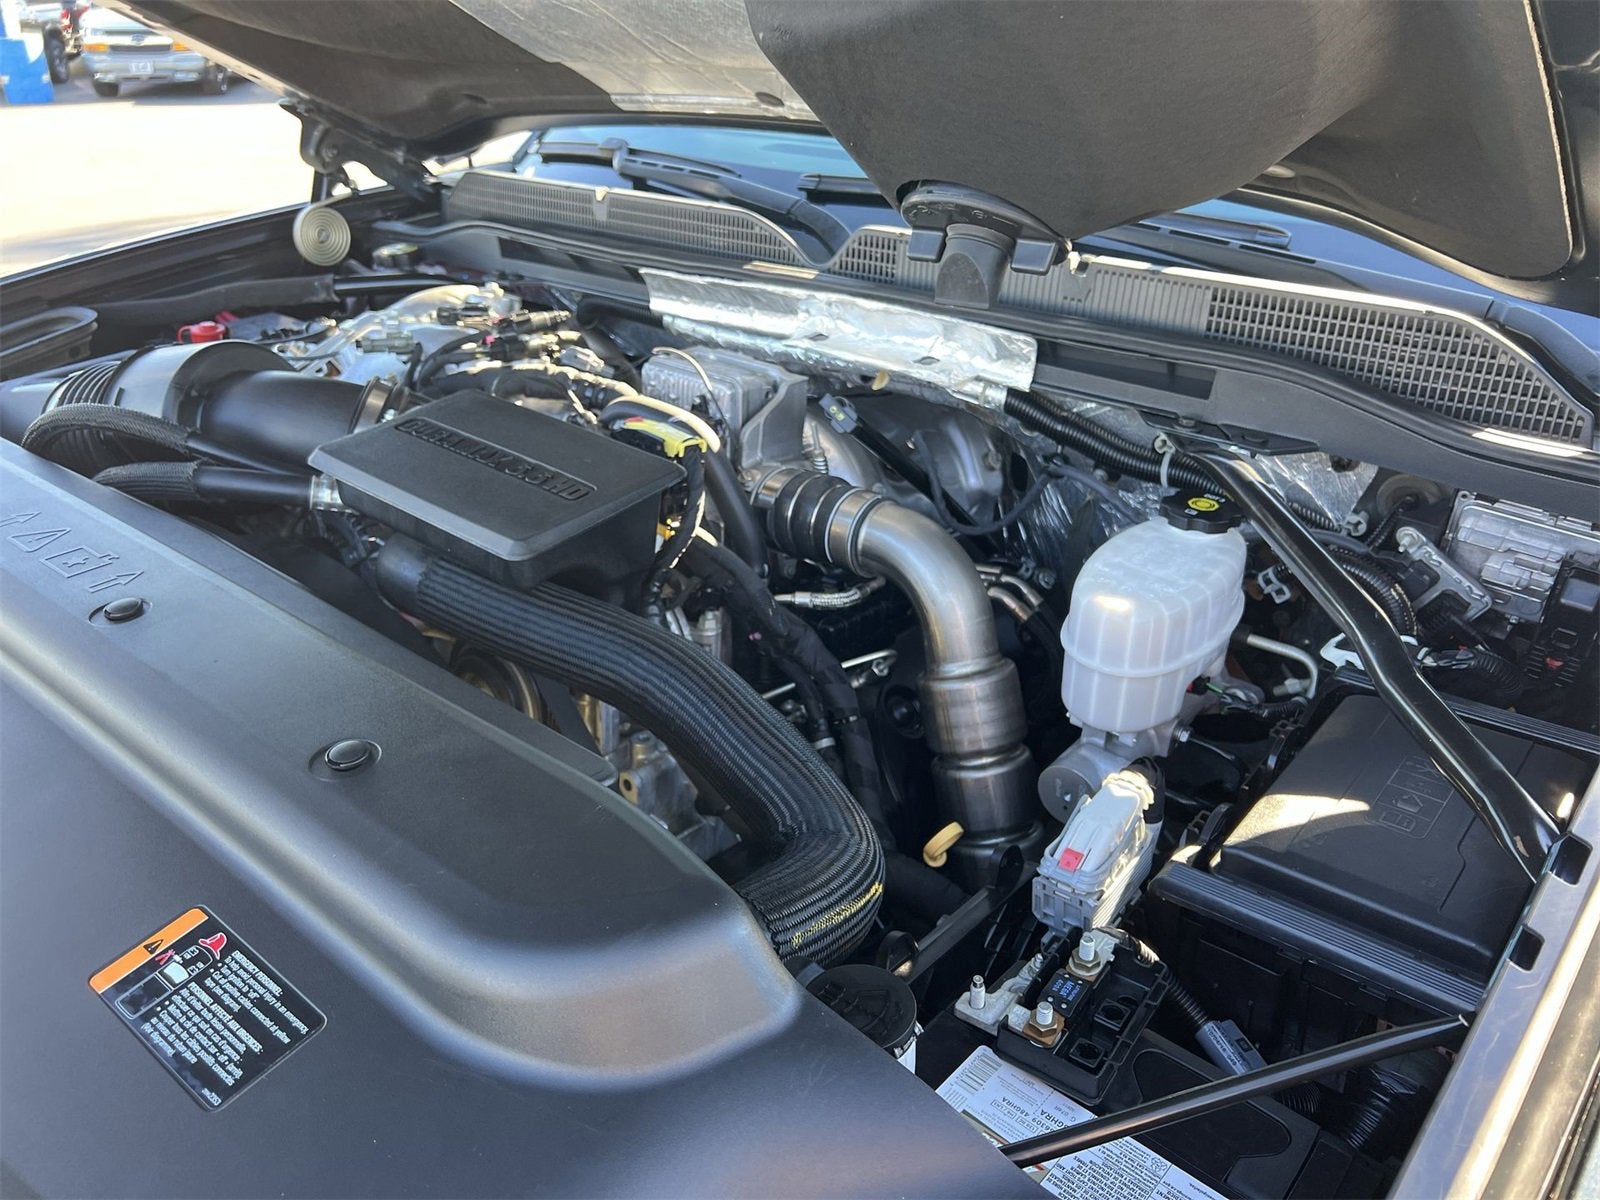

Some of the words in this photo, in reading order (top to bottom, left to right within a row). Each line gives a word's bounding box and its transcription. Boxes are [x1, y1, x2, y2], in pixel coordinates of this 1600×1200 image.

[398, 420, 513, 469] DURAMAX
[540, 475, 590, 501] HD
[1000, 1095, 1030, 1119] 48GHRA
